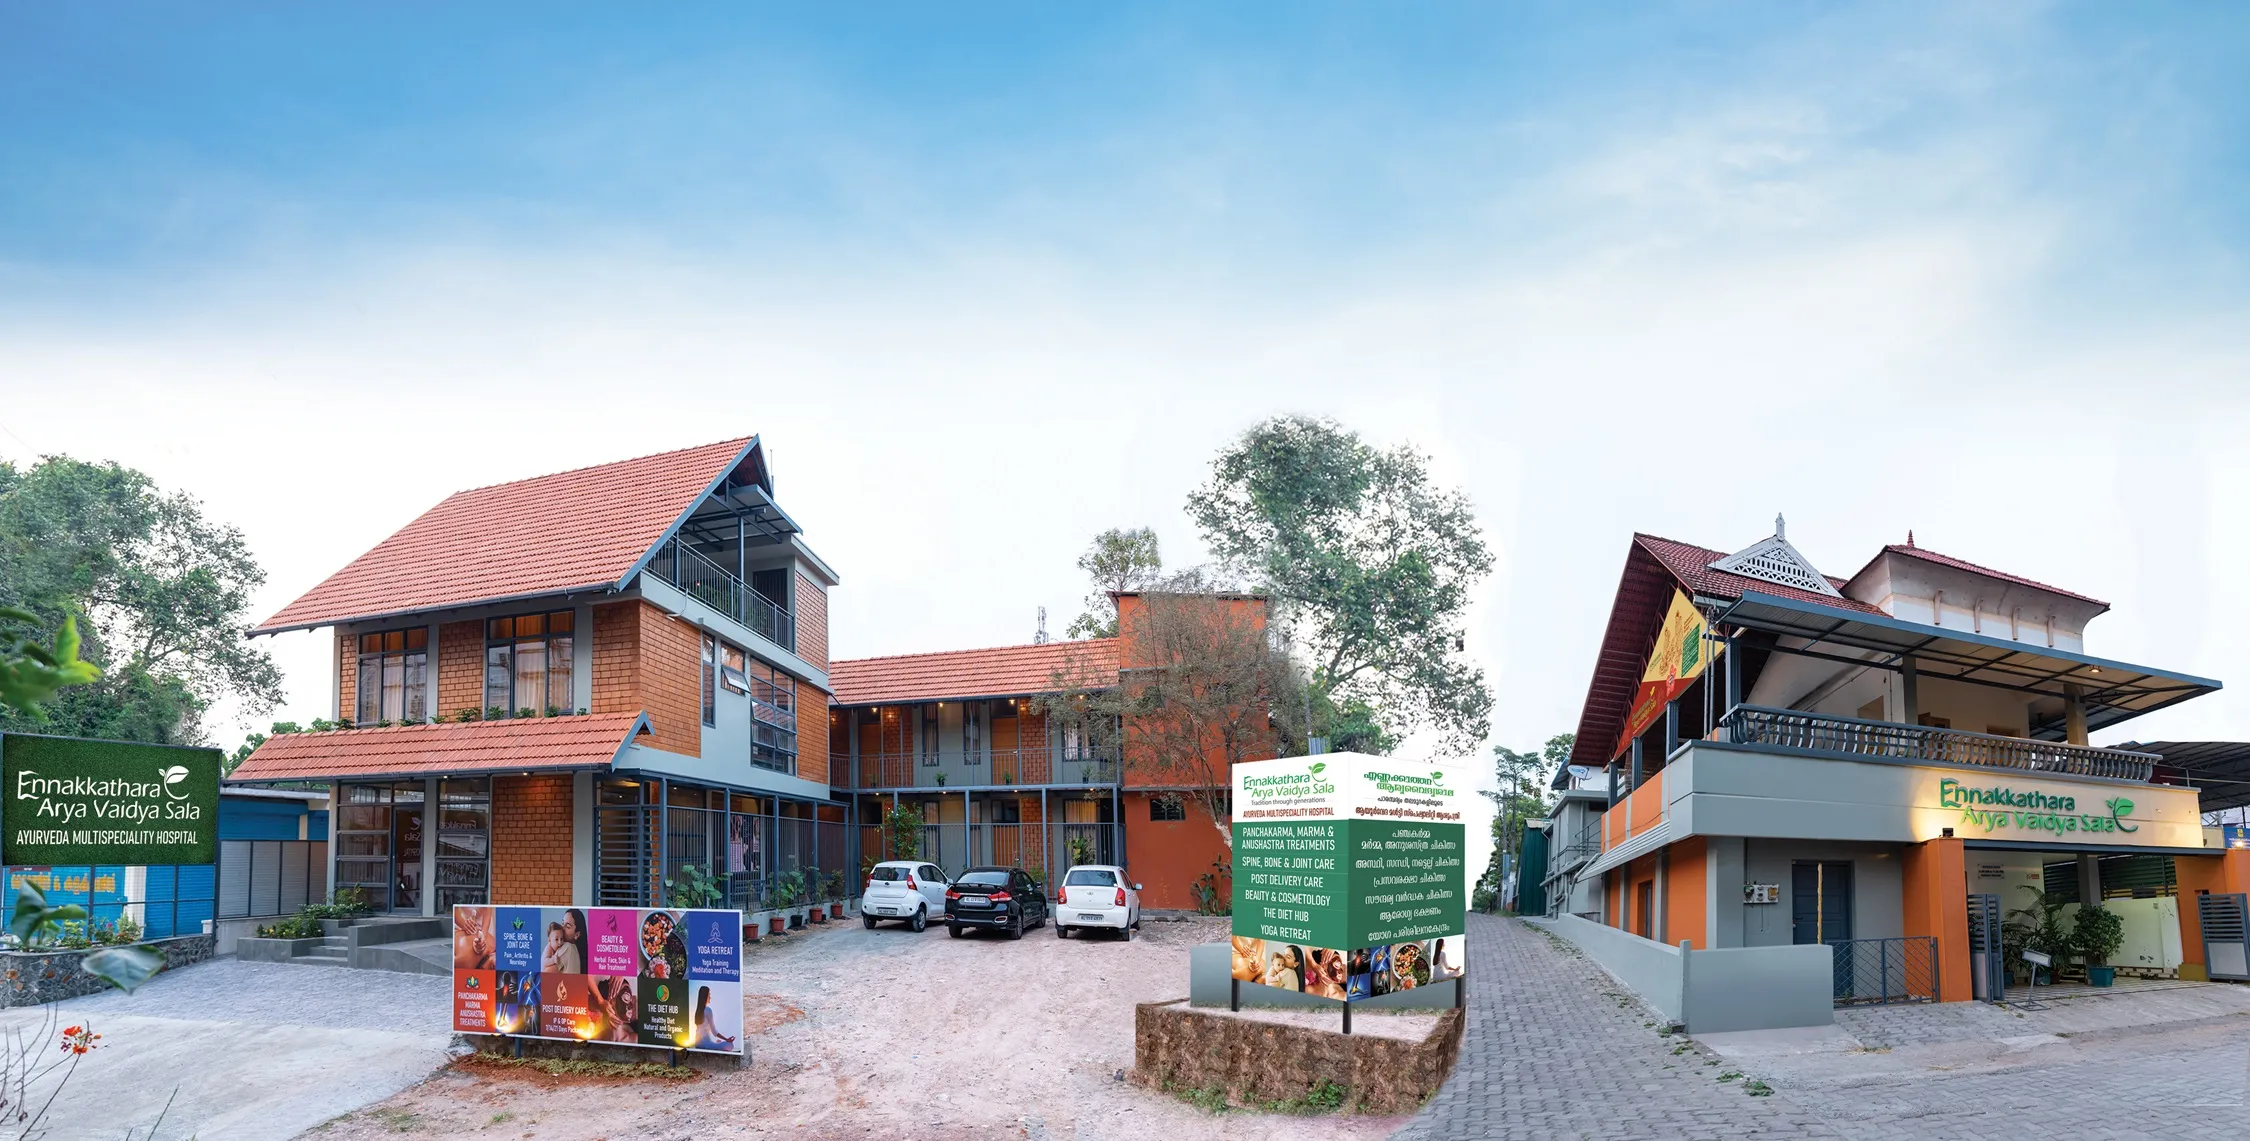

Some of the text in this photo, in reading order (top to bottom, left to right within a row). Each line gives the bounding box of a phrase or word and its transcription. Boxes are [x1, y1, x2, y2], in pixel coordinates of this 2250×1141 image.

[17, 770, 161, 800] Ennakkathara
[1243, 774, 1310, 791] Ennakkathara
[1251, 783, 1334, 800] Arya Vaidya Sala
[1940, 777, 2076, 812] Ennakkathara
[1273, 798, 1293, 806] through
[1294, 797, 1325, 805] generations
[36, 798, 200, 825] Arya Vaidya Sala
[1243, 807, 1334, 818] AYURVEDA MULTISPECIALITY HOSPITAL
[1961, 805, 2116, 836] Arya Vaidya Sala
[1242, 826, 1334, 838] PANCHAKARMA, MARMA &
[16, 830, 198, 845] AYURVEDA MULTISPECIALITY HOSPITAL
[1241, 839, 1335, 850] ANUSHASTRA TREATMENTS
[1242, 856, 1335, 870] SPINE, BONE & JOINT CARE
[1251, 874, 1323, 888] POST DELIVERY CARE
[1245, 890, 1331, 906] BEAUTY & COSMETOLOGY
[1264, 907, 1309, 922] THE DIET HUB
[503, 932, 533, 941] SPINE, BONE &
[1261, 924, 1312, 941] YOGA RETREAT
[602, 935, 623, 944] BEAUTY &
[506, 941, 530, 949] JOINT CARE
[596, 944, 629, 953] COSMETOLOGY
[697, 946, 733, 956] YOGA RETREAT
[509, 959, 527, 967] Neurology
[607, 963, 626, 971] Treatment
[701, 959, 729, 968] Yoga Training
[722, 968, 739, 976] Therapy
[542, 1005, 587, 1015] POST DELIVERY CARE
[648, 1004, 678, 1014] THE DIET HUB
[651, 1016, 666, 1024] Healthy
[667, 1025, 683, 1033] Organic
[654, 1032, 672, 1040] Products
